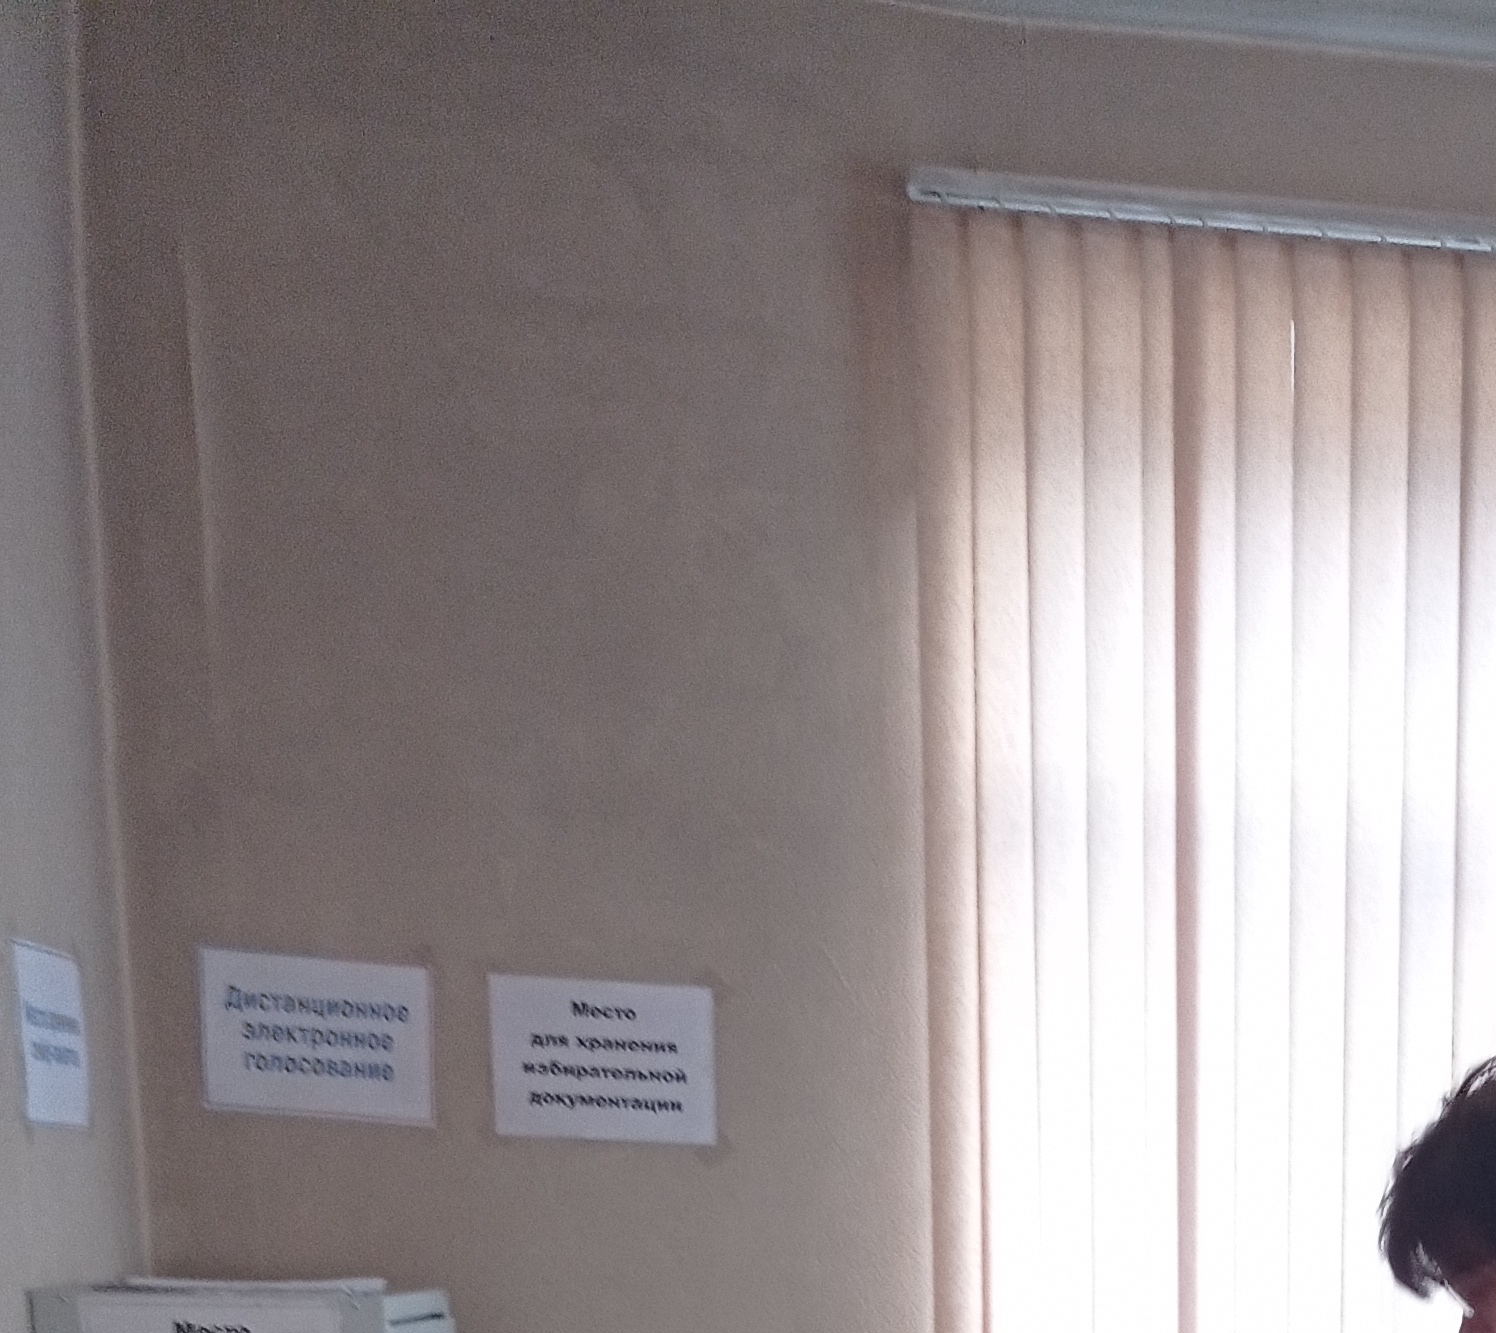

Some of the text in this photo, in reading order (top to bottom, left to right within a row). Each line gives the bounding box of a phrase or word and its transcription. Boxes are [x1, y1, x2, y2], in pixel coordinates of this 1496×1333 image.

[224, 984, 409, 1023] Дистанционное
[570, 1000, 637, 1021] Место
[243, 1021, 395, 1052] электронное
[531, 1033, 678, 1054] для хранения
[244, 1050, 395, 1081] голосование
[522, 1060, 687, 1084] избирательной
[530, 1091, 683, 1114] документации
